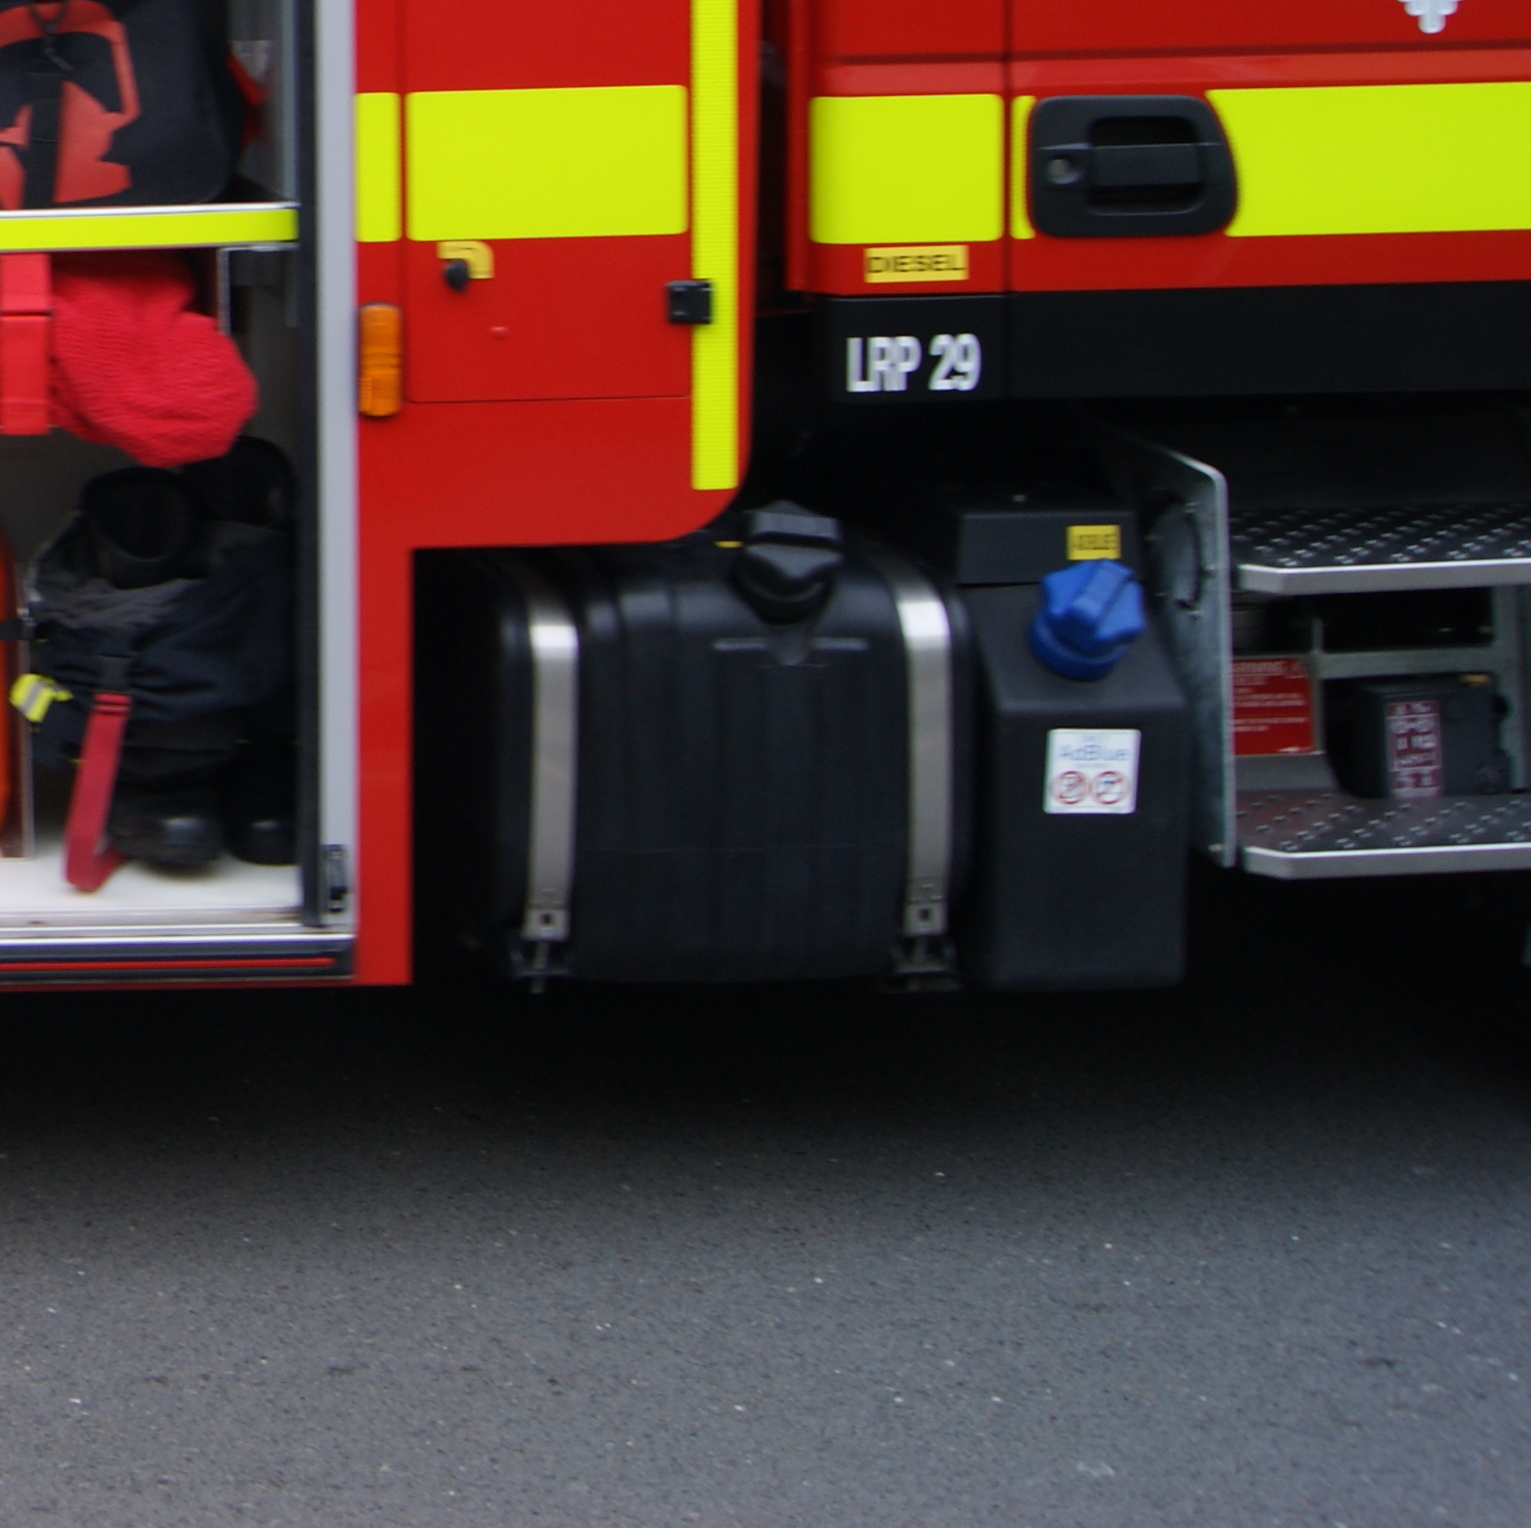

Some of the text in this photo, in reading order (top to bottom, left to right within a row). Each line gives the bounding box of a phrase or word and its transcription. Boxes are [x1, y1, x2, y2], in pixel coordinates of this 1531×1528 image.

[868, 255, 966, 273] DIESEL
[846, 333, 982, 392] LRP 29
